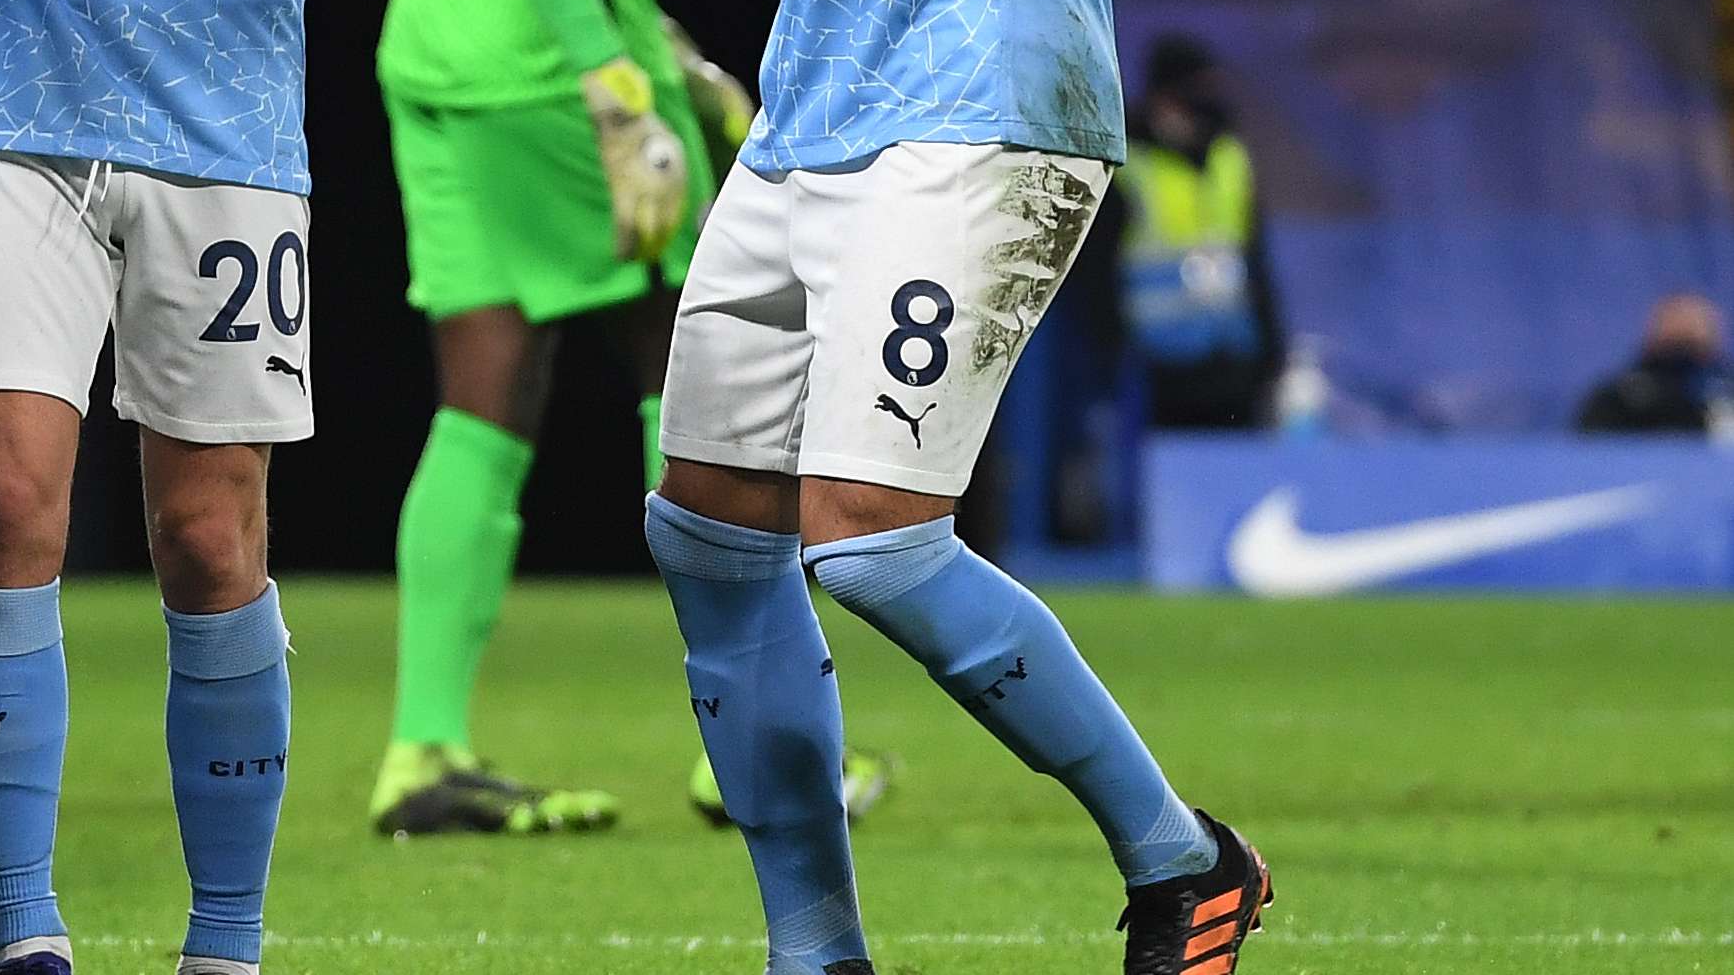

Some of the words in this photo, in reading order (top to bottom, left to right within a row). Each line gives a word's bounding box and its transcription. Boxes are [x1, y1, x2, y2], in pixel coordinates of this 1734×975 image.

[198, 230, 306, 343] 20
[881, 278, 955, 388] 8
[209, 748, 287, 777] CITY
